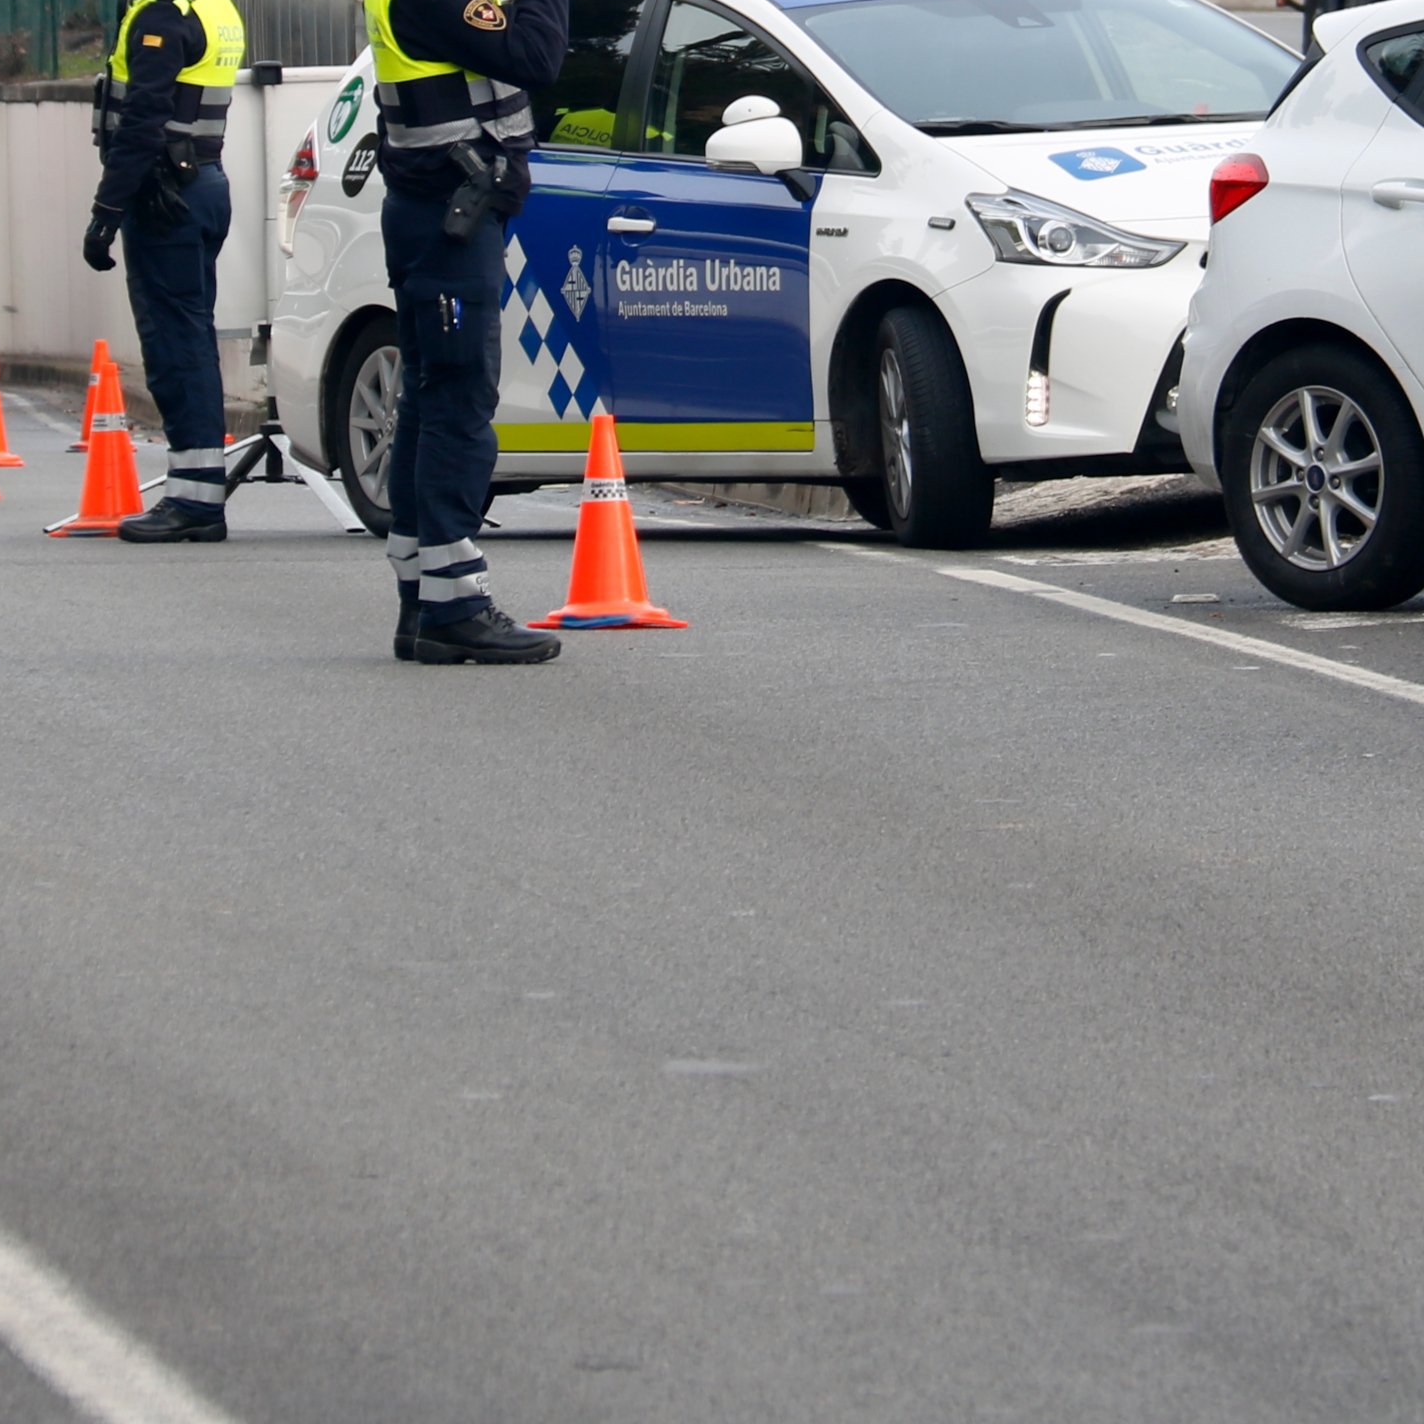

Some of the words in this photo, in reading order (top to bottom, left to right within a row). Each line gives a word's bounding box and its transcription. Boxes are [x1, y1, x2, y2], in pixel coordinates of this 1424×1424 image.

[348, 149, 376, 172] 112
[615, 259, 698, 292] Guàrdia
[705, 259, 781, 292] Urbana
[617, 300, 671, 320] Ajuntament
[672, 301, 683, 317] de
[684, 300, 728, 317] Barcelona
